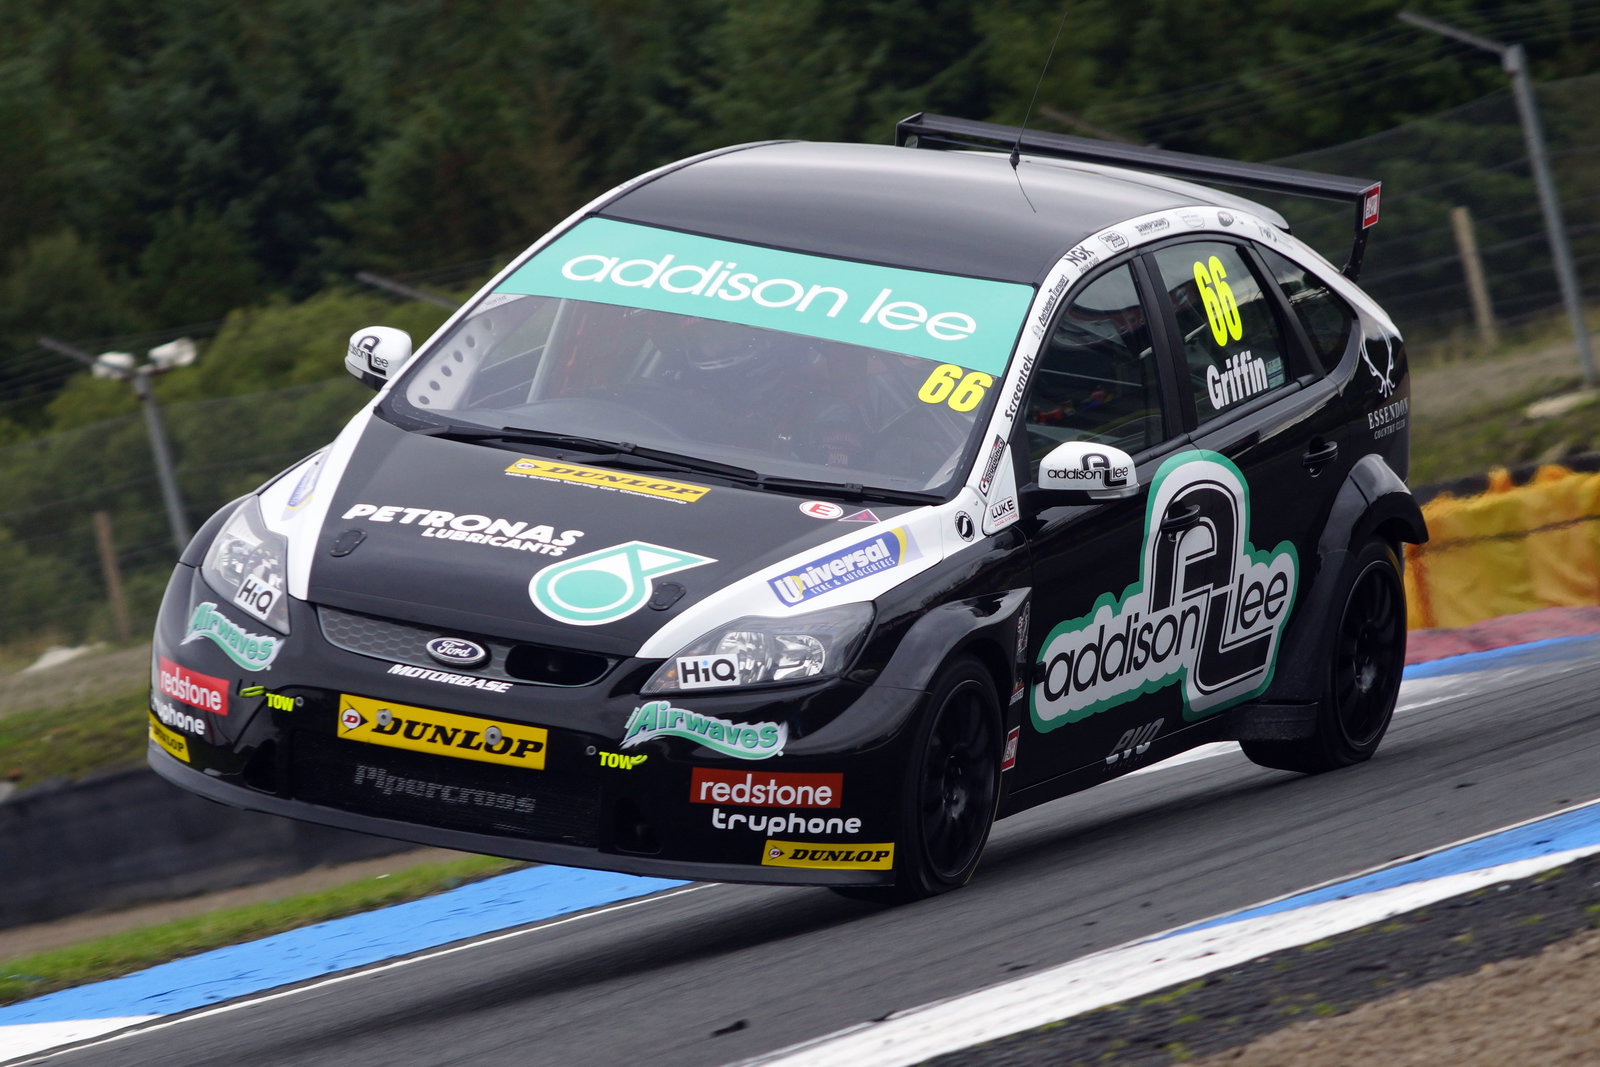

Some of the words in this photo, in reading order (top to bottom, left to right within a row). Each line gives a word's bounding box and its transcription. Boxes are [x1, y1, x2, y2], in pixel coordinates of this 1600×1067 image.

[1062, 245, 1095, 267] NGK
[561, 254, 848, 318] addison
[859, 288, 977, 341] lee
[1193, 255, 1243, 347] 66
[917, 363, 993, 413] 66
[1004, 354, 1034, 422] Screentek
[1206, 350, 1268, 410] Griffin
[1368, 397, 1408, 430] ESSENDON
[543, 467, 703, 494] DUNLOP
[1047, 467, 1102, 480] addison
[1112, 465, 1129, 478] lee
[341, 503, 585, 548] PETRONAS
[808, 503, 835, 516] E
[991, 500, 1014, 519] LUKE
[421, 526, 568, 557] LUBRICANTS
[774, 538, 891, 603] Universal
[810, 584, 832, 595] TYRE
[833, 578, 841, 587] &
[843, 557, 896, 583] AUTOCENTRES
[237, 580, 274, 615] HiQ
[188, 602, 276, 662] Airwaves
[1043, 604, 1201, 703] addison
[1231, 571, 1288, 635] lee
[437, 639, 473, 659] Ford
[387, 664, 514, 693] MOTORBASE
[680, 658, 737, 684] HiQ
[160, 666, 222, 711] redstone
[266, 692, 294, 712] TOW
[371, 713, 544, 759] DUNLOP
[626, 701, 780, 749] Airwaves
[599, 751, 634, 770] TOW
[699, 773, 833, 806] redstone
[711, 807, 862, 837] truphone
[788, 848, 891, 863] DUNLOP
